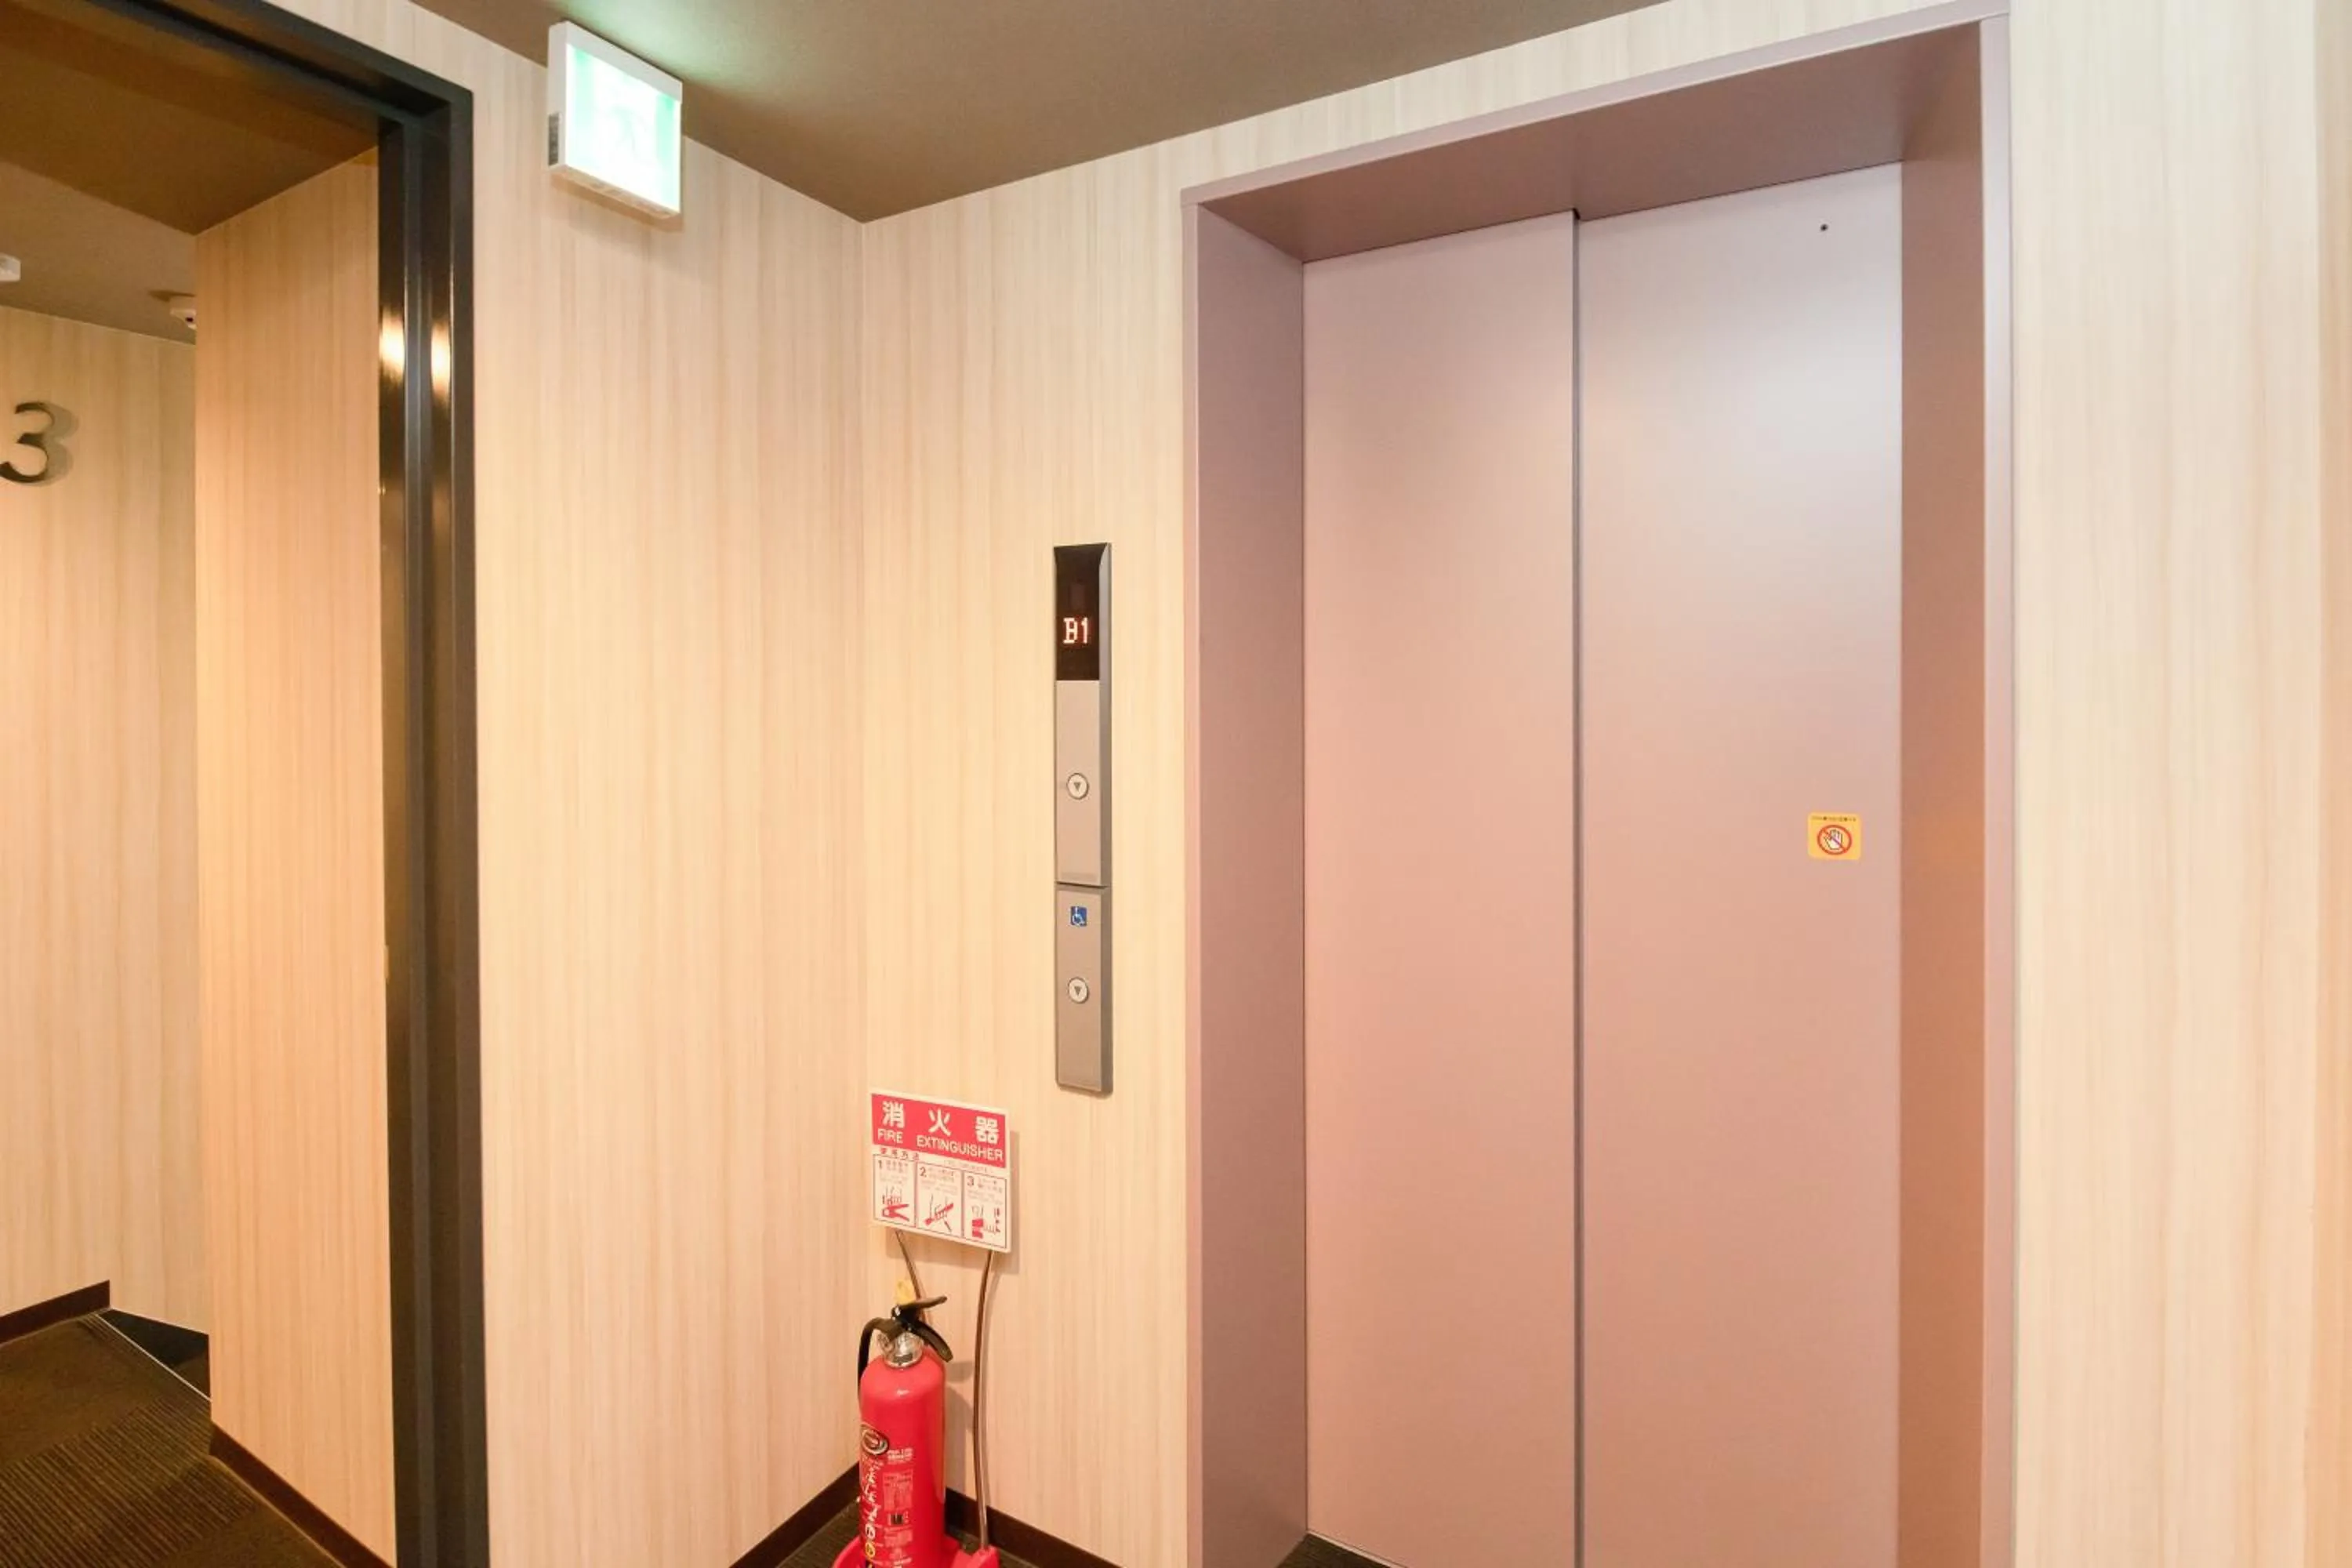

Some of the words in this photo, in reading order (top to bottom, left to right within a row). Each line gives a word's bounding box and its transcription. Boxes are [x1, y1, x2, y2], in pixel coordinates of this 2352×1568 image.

[0, 401, 54, 484] 3
[1063, 617, 1088, 644] B1
[882, 1100, 999, 1145] 消火器
[877, 1128, 904, 1144] FIRE
[916, 1134, 1004, 1162] EXTINGUISHER
